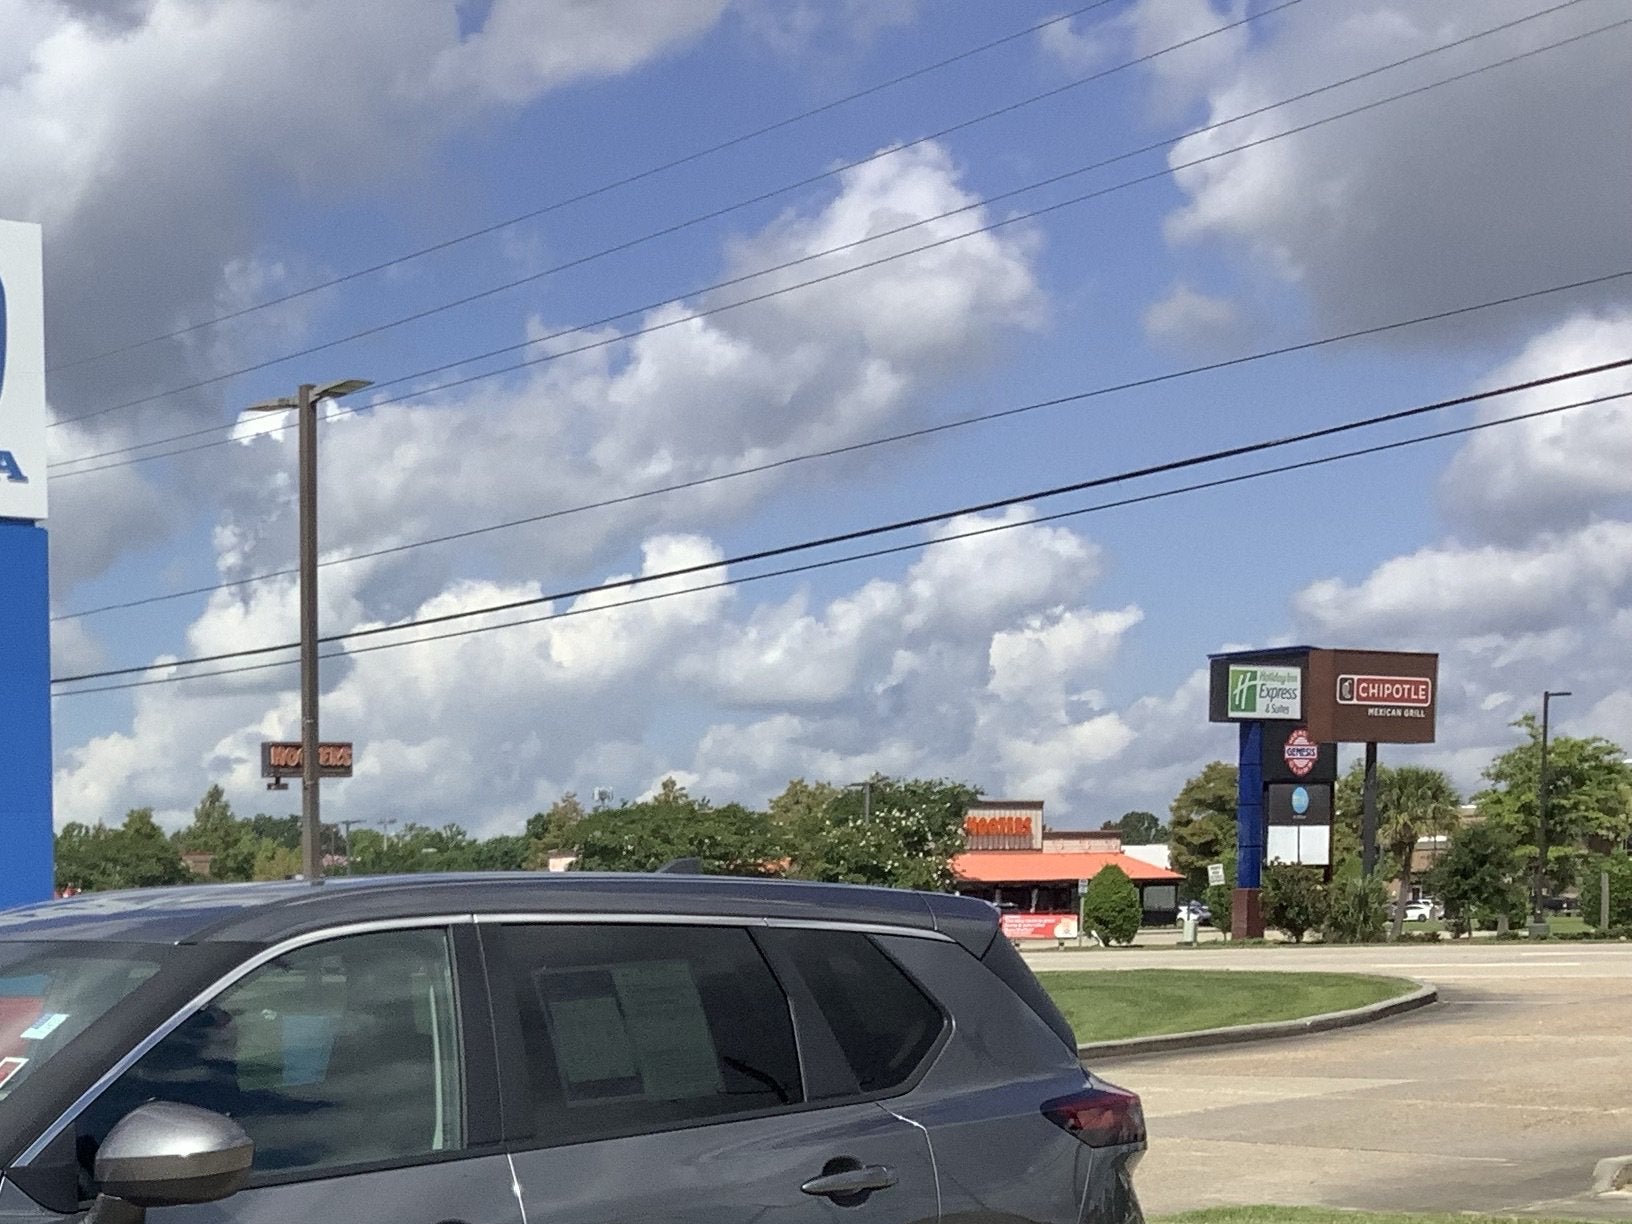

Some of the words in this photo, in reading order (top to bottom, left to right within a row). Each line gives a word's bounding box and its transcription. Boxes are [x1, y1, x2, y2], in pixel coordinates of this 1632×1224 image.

[1259, 671, 1287, 684] Holiday
[1259, 683, 1298, 702] Express
[1358, 682, 1427, 700] CHIPOTLE
[1271, 704, 1290, 715] Suites
[1367, 707, 1402, 717] MEXICAN
[1404, 708, 1426, 718] GRILL
[967, 816, 1033, 836] HOOTERS
